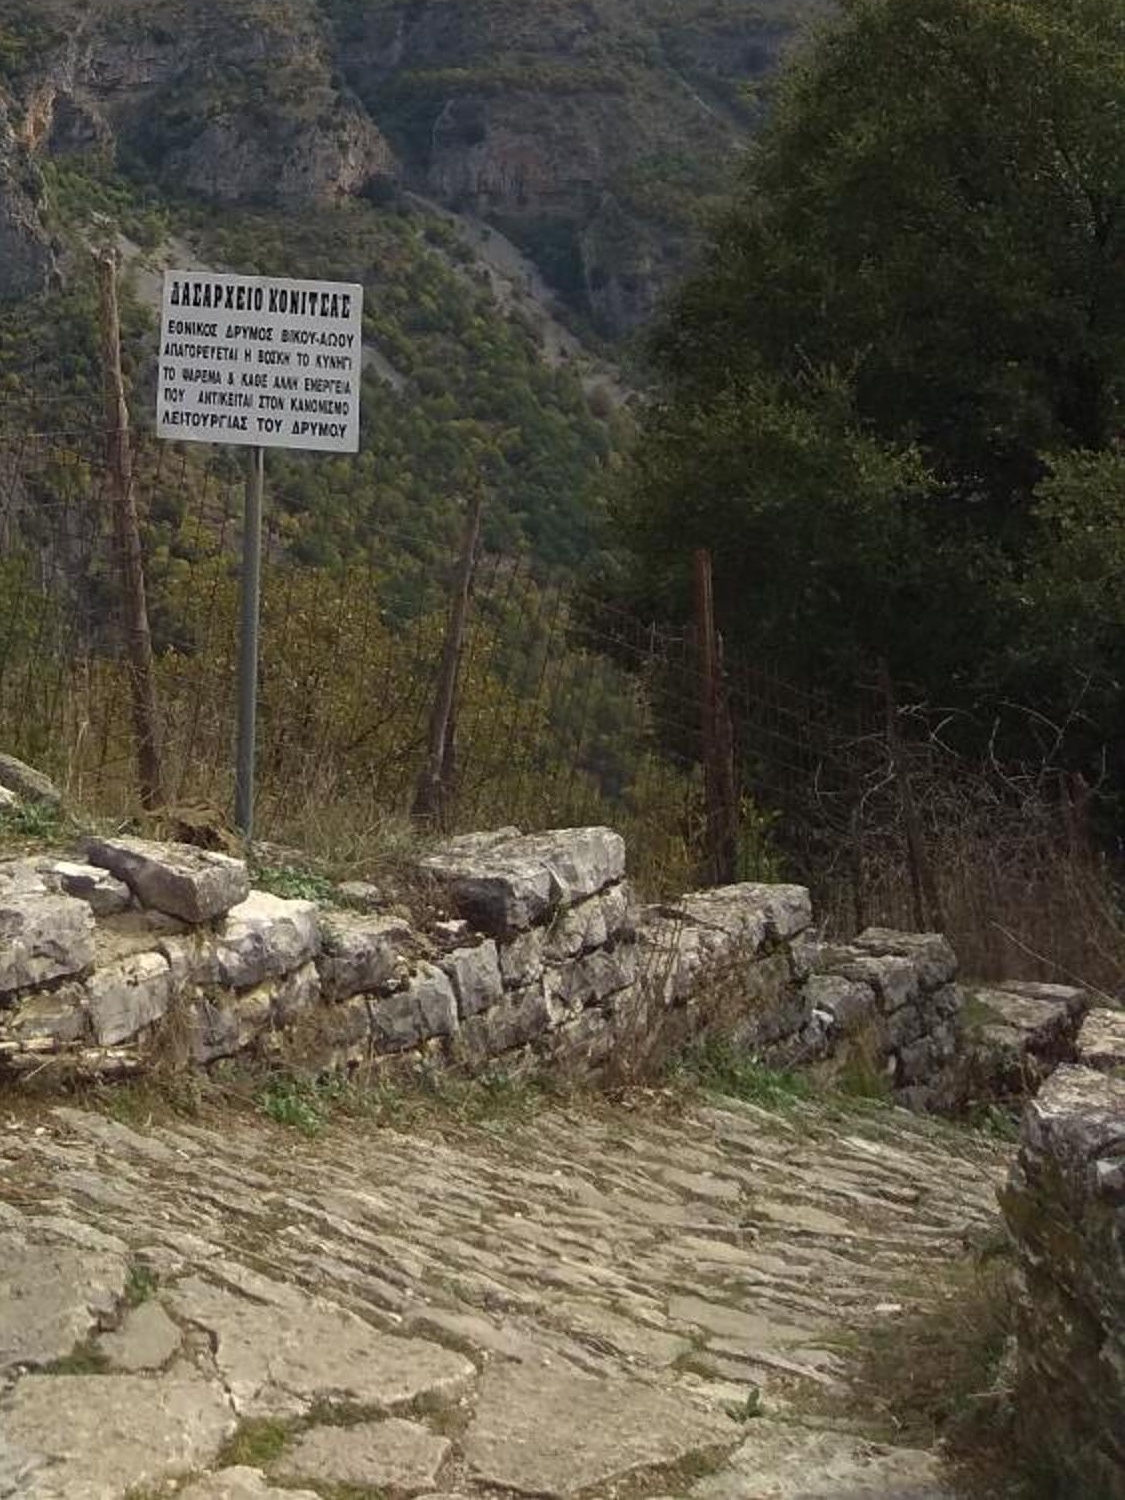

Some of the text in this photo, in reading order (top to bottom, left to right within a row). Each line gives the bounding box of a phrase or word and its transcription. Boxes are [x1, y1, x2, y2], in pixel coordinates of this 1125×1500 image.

[171, 282, 351, 318] ΔΑΣΑΡΧΕΙΟ ΚΟΝΙΤΣΑΣ
[168, 320, 217, 337] ΕΘΝΙΚΟΣ
[226, 325, 273, 341] ΔΡΥΜΟΣ
[164, 343, 238, 360] ΑΠΑΓΟΡΕΥΕΤΑΙ
[297, 353, 310, 366] ΤΟ
[163, 366, 175, 380] ΤΟ
[241, 373, 268, 388] ΚΑΘΕ
[164, 387, 349, 415] ΠΟΥ ΑΝΤΙΚΕΙΤΑΙ ΣΤΟΝ ΚΑΝΟΝΙΣΜΟ
[162, 410, 347, 438] ΛΕΙΤΟΥΡΓΙΑΣ ΤΟΥ ΔΡΥΜΟΥ
